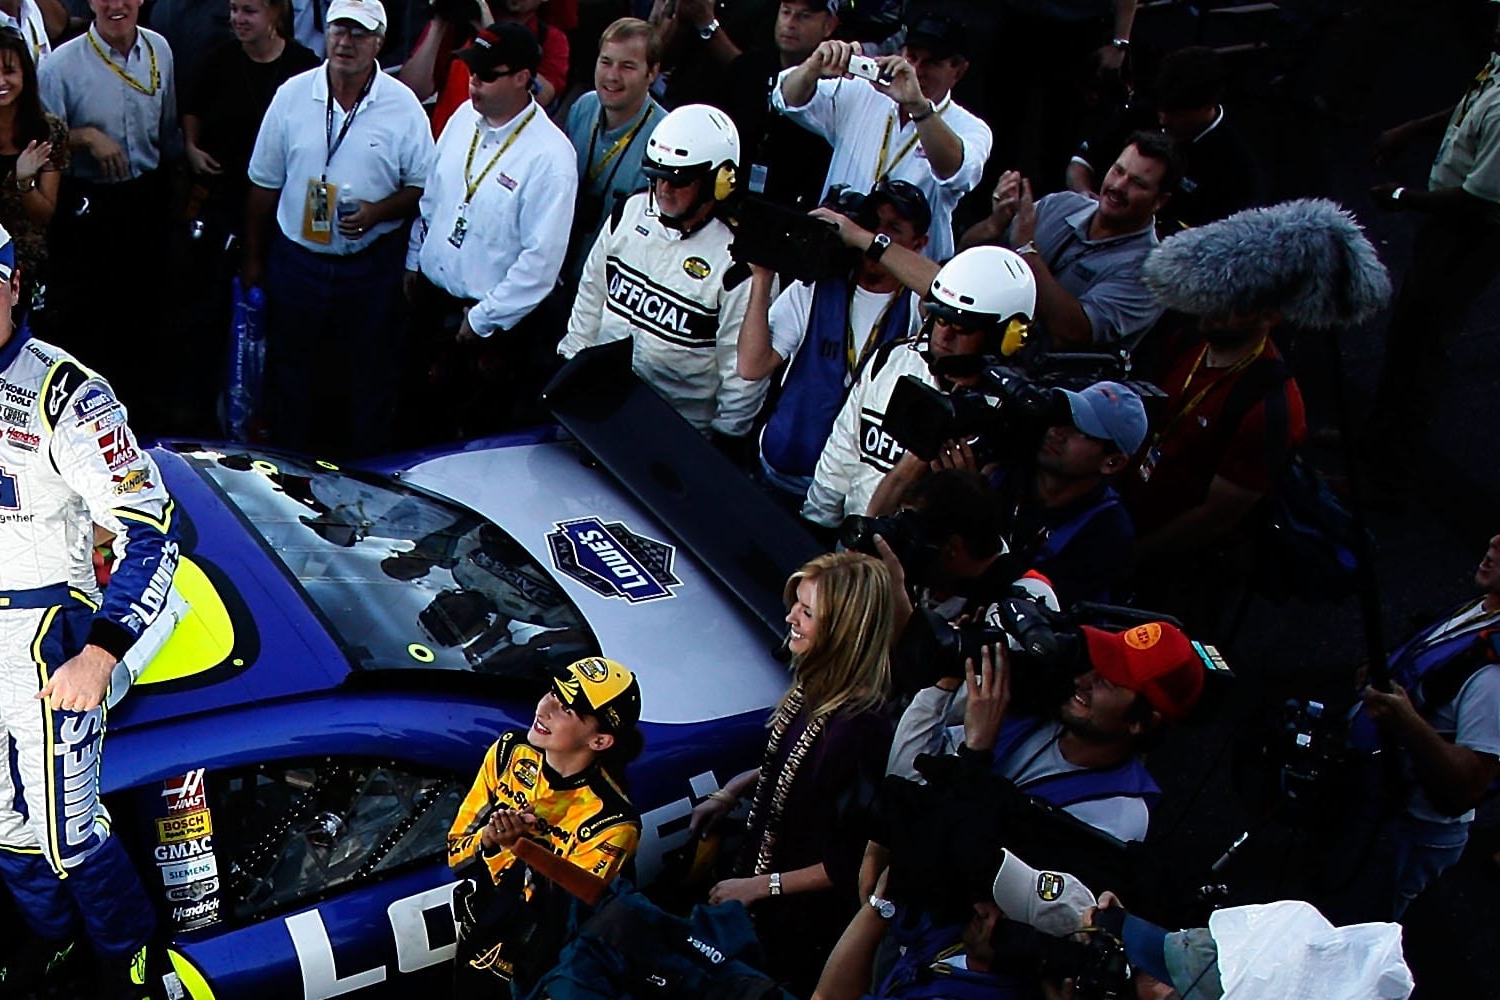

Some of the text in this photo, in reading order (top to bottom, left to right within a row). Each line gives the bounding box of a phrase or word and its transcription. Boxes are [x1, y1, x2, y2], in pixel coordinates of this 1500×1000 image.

[608, 272, 692, 335] OFFICIAL
[6, 392, 32, 407] TOOLS
[577, 529, 649, 590] LOWE'S
[130, 540, 179, 627] LOWE'S
[53, 704, 102, 868] LOWE'S
[163, 815, 205, 832] BOSCH
[154, 835, 214, 861] GMAC
[169, 864, 211, 880] SIEMENS
[172, 897, 220, 922] Hendrick
